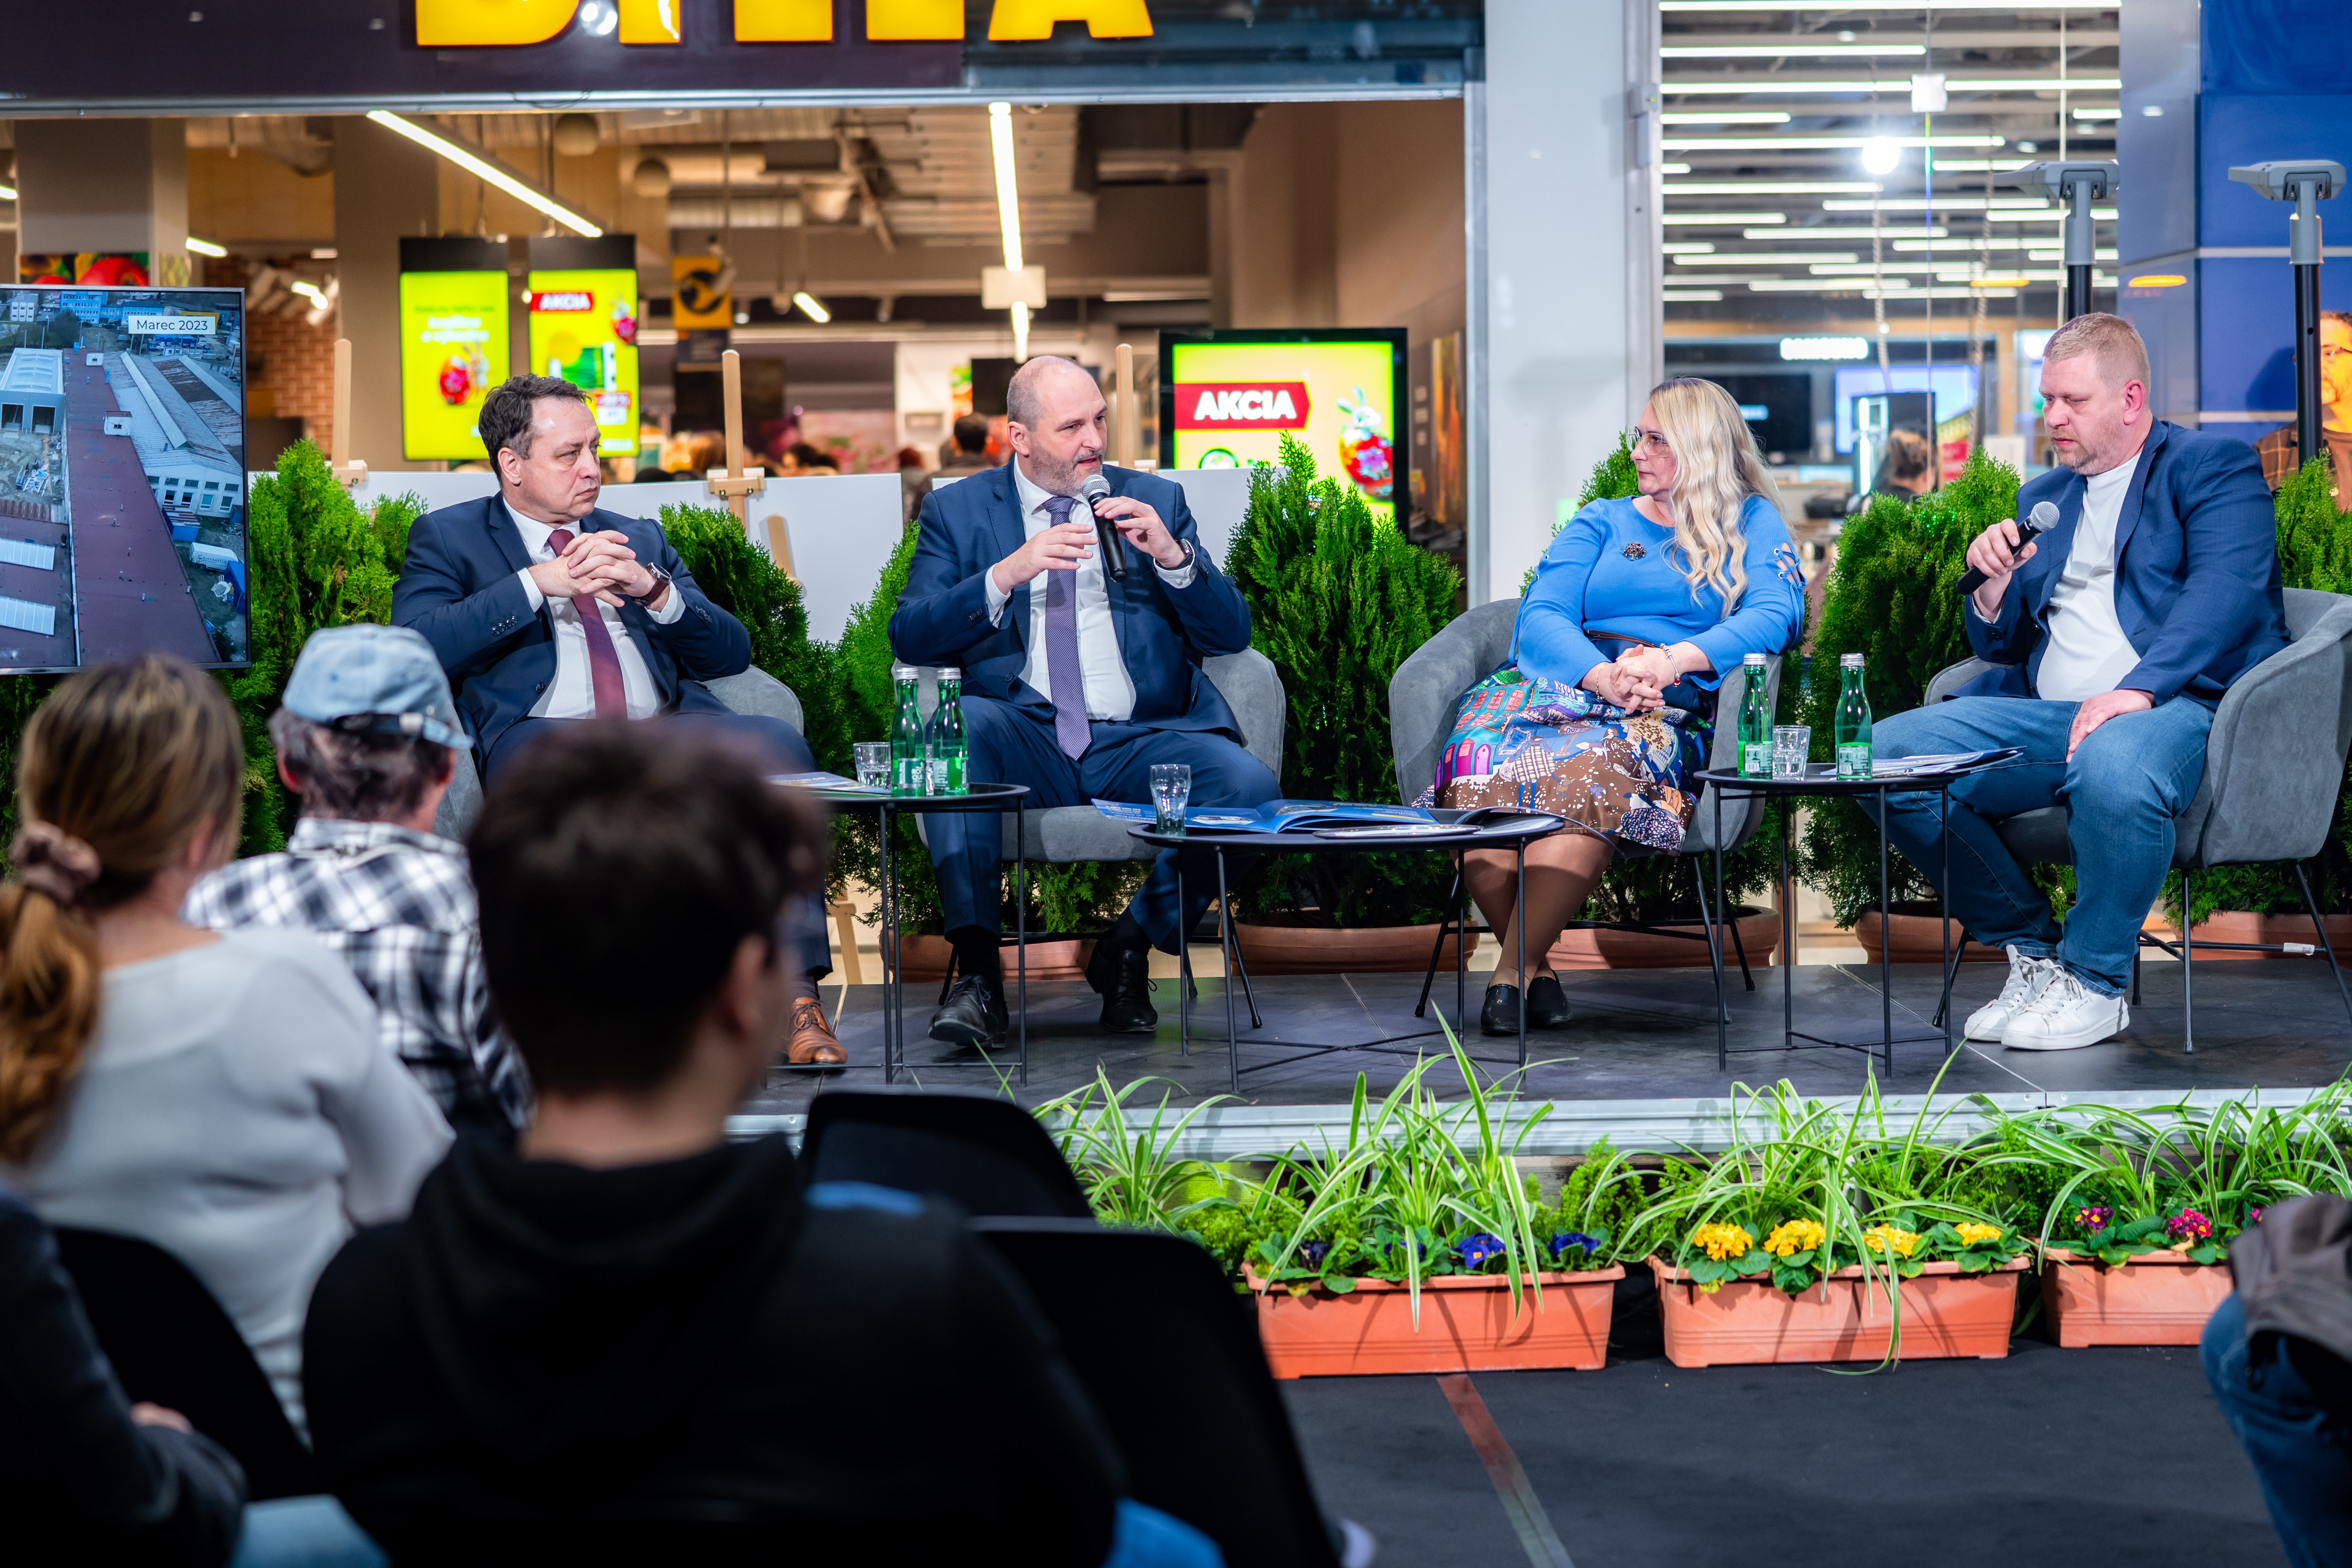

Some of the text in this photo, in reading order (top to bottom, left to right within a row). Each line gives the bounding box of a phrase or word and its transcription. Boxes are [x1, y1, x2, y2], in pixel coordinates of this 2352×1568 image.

[137, 320, 208, 330] Marec 2023
[1194, 390, 1297, 420] AKCIA
[2075, 999, 2089, 1011] REPLAY
